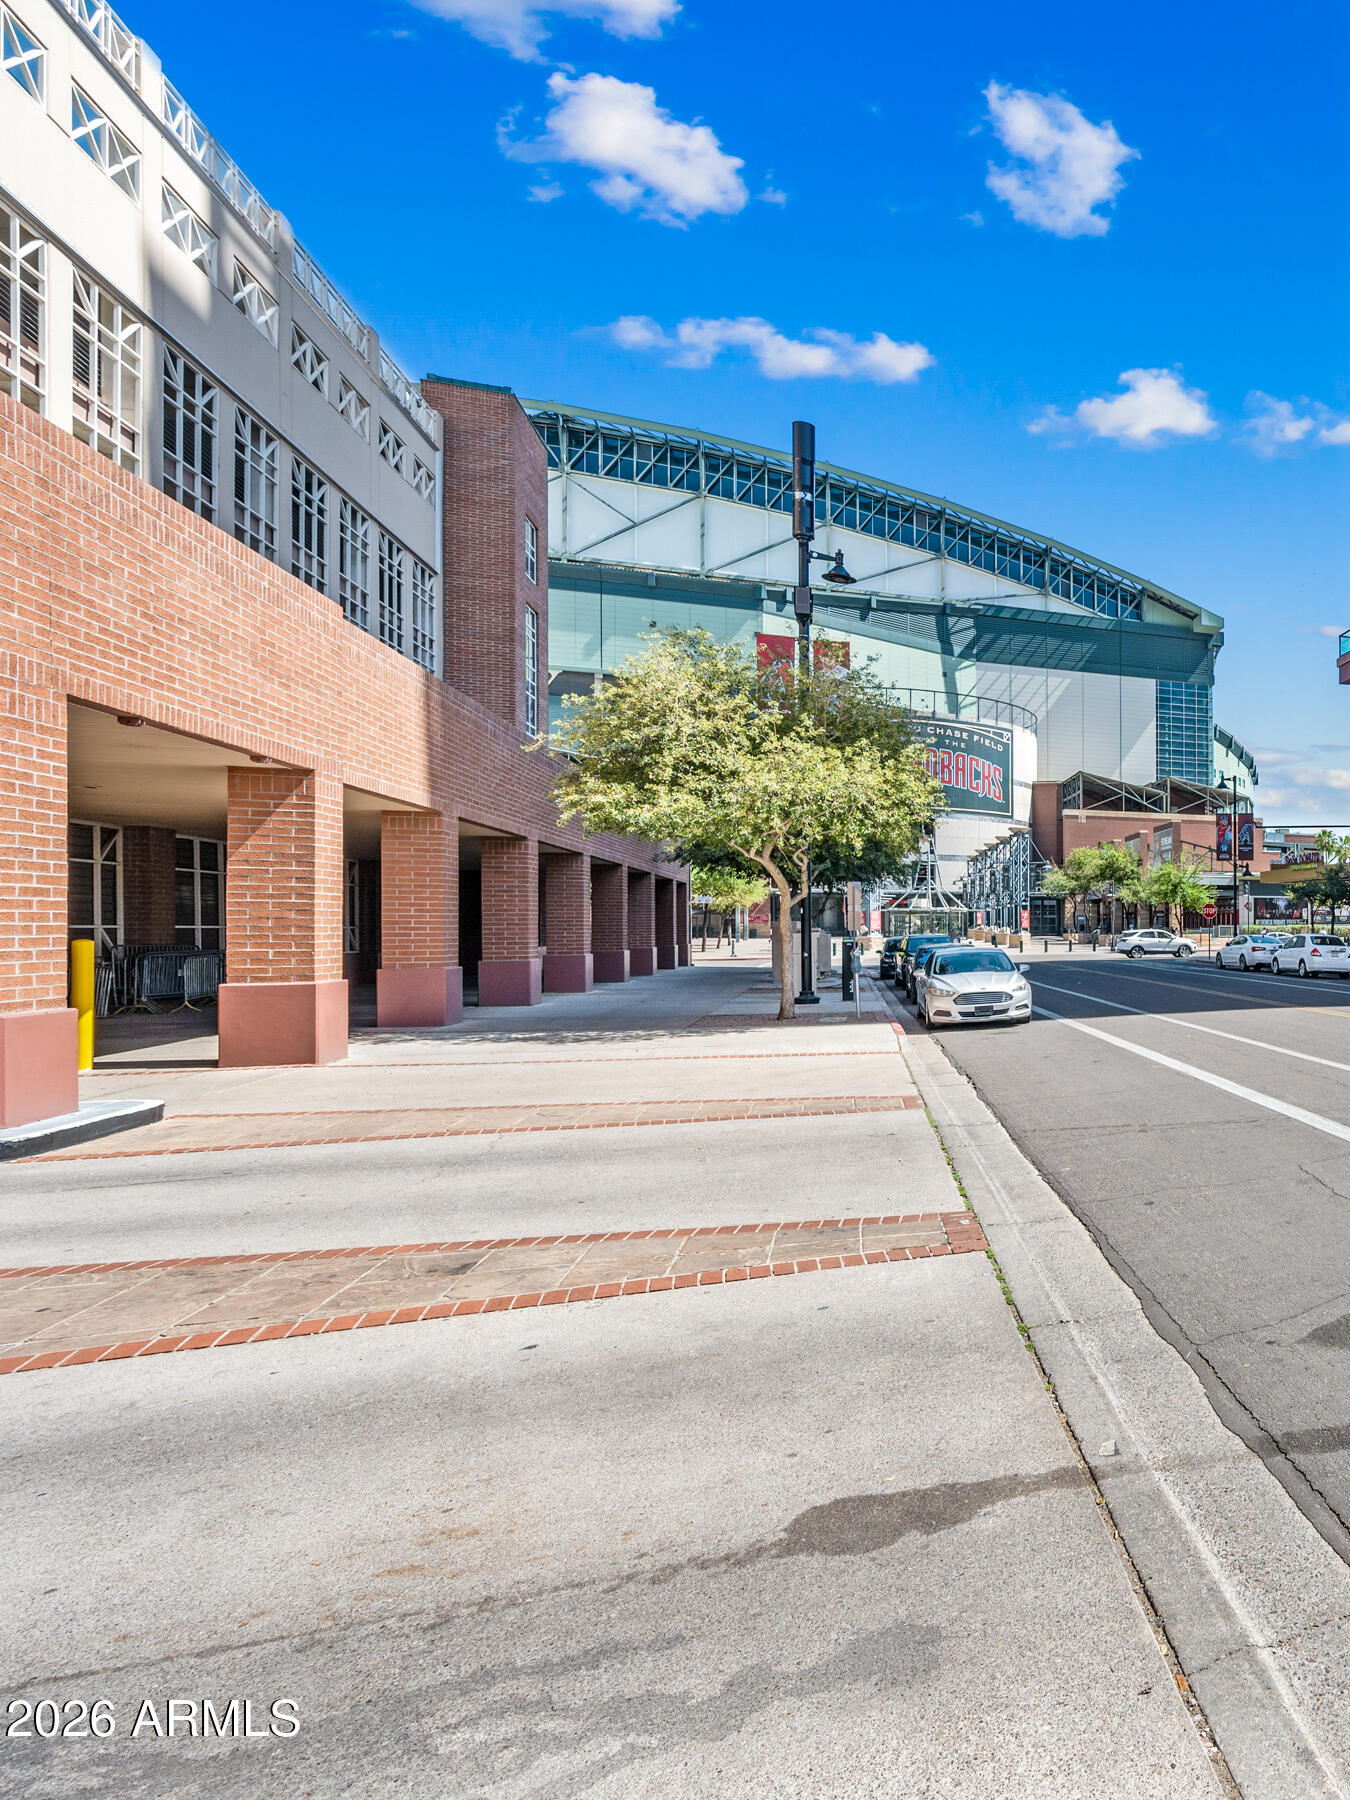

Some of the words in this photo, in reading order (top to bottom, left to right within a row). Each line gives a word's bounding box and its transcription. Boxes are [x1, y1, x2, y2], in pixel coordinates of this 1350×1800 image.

[926, 726, 969, 740] CHASE
[973, 734, 1004, 752] FIELD
[944, 739, 967, 749] THE
[1203, 907, 1217, 915] STOP
